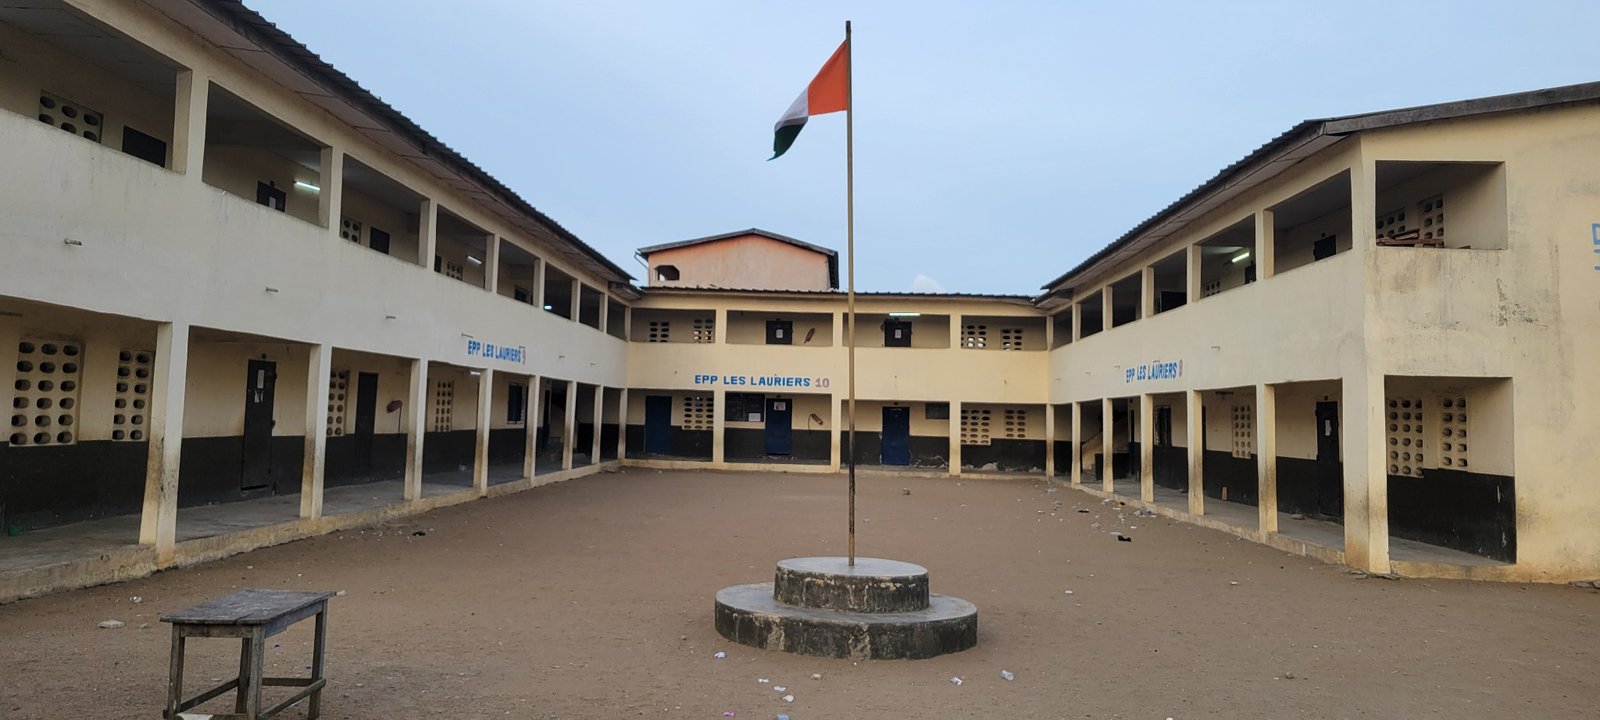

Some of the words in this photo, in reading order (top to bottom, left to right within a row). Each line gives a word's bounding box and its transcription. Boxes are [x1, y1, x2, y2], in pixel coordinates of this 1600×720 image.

[467, 339, 481, 355] EPP
[482, 342, 494, 358] LES
[495, 345, 521, 363] LAURIERS
[694, 374, 718, 385] EPP
[723, 375, 746, 386] LES
[750, 376, 811, 387] LAURIERS
[815, 377, 830, 388] 10
[1125, 367, 1135, 383] EPP
[1136, 364, 1147, 380] LES
[1147, 361, 1178, 380] LAURIERS
